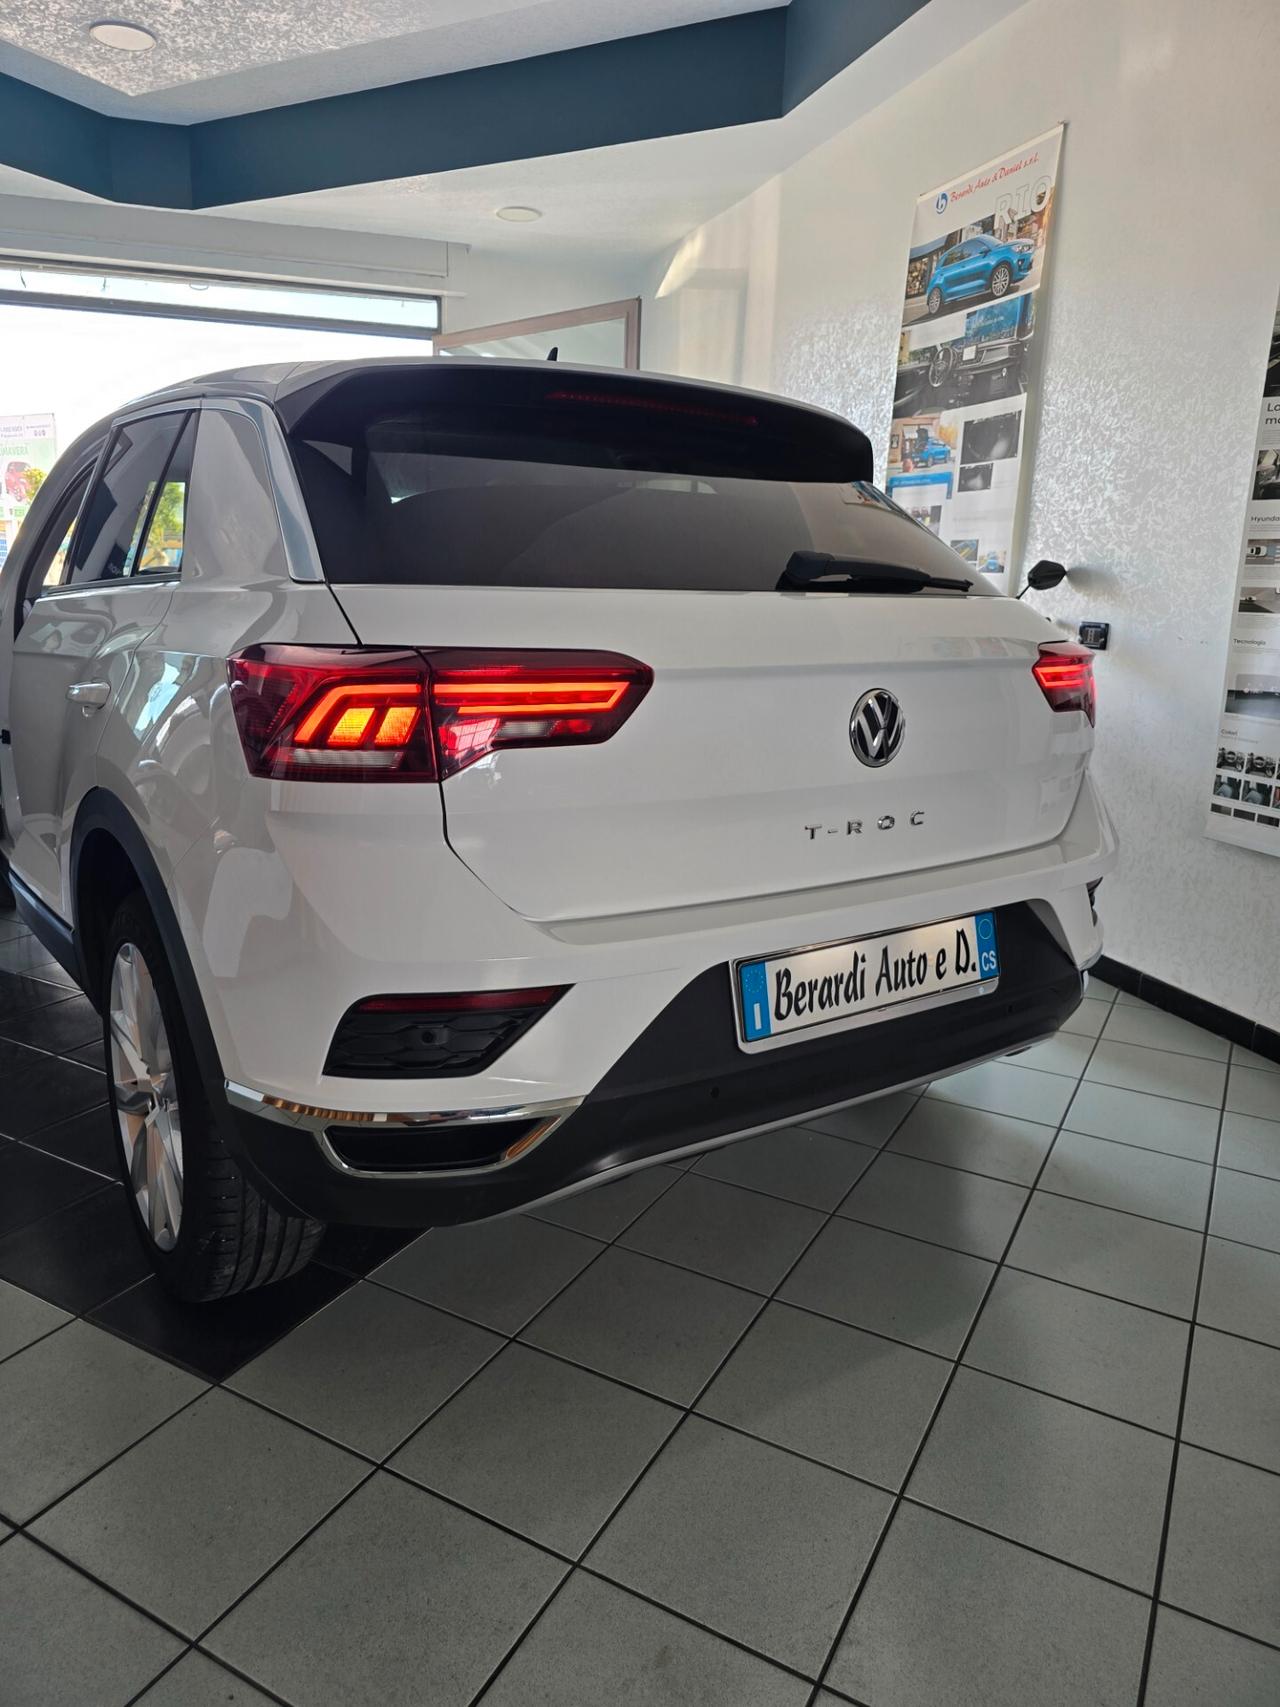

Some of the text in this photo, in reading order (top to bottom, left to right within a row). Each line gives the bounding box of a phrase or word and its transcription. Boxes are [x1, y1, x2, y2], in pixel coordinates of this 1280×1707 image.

[804, 810, 926, 840] T-ROC
[774, 927, 977, 1021] Berardi Auto e D.
[981, 950, 998, 972] CS
[753, 1002, 762, 1030] I
